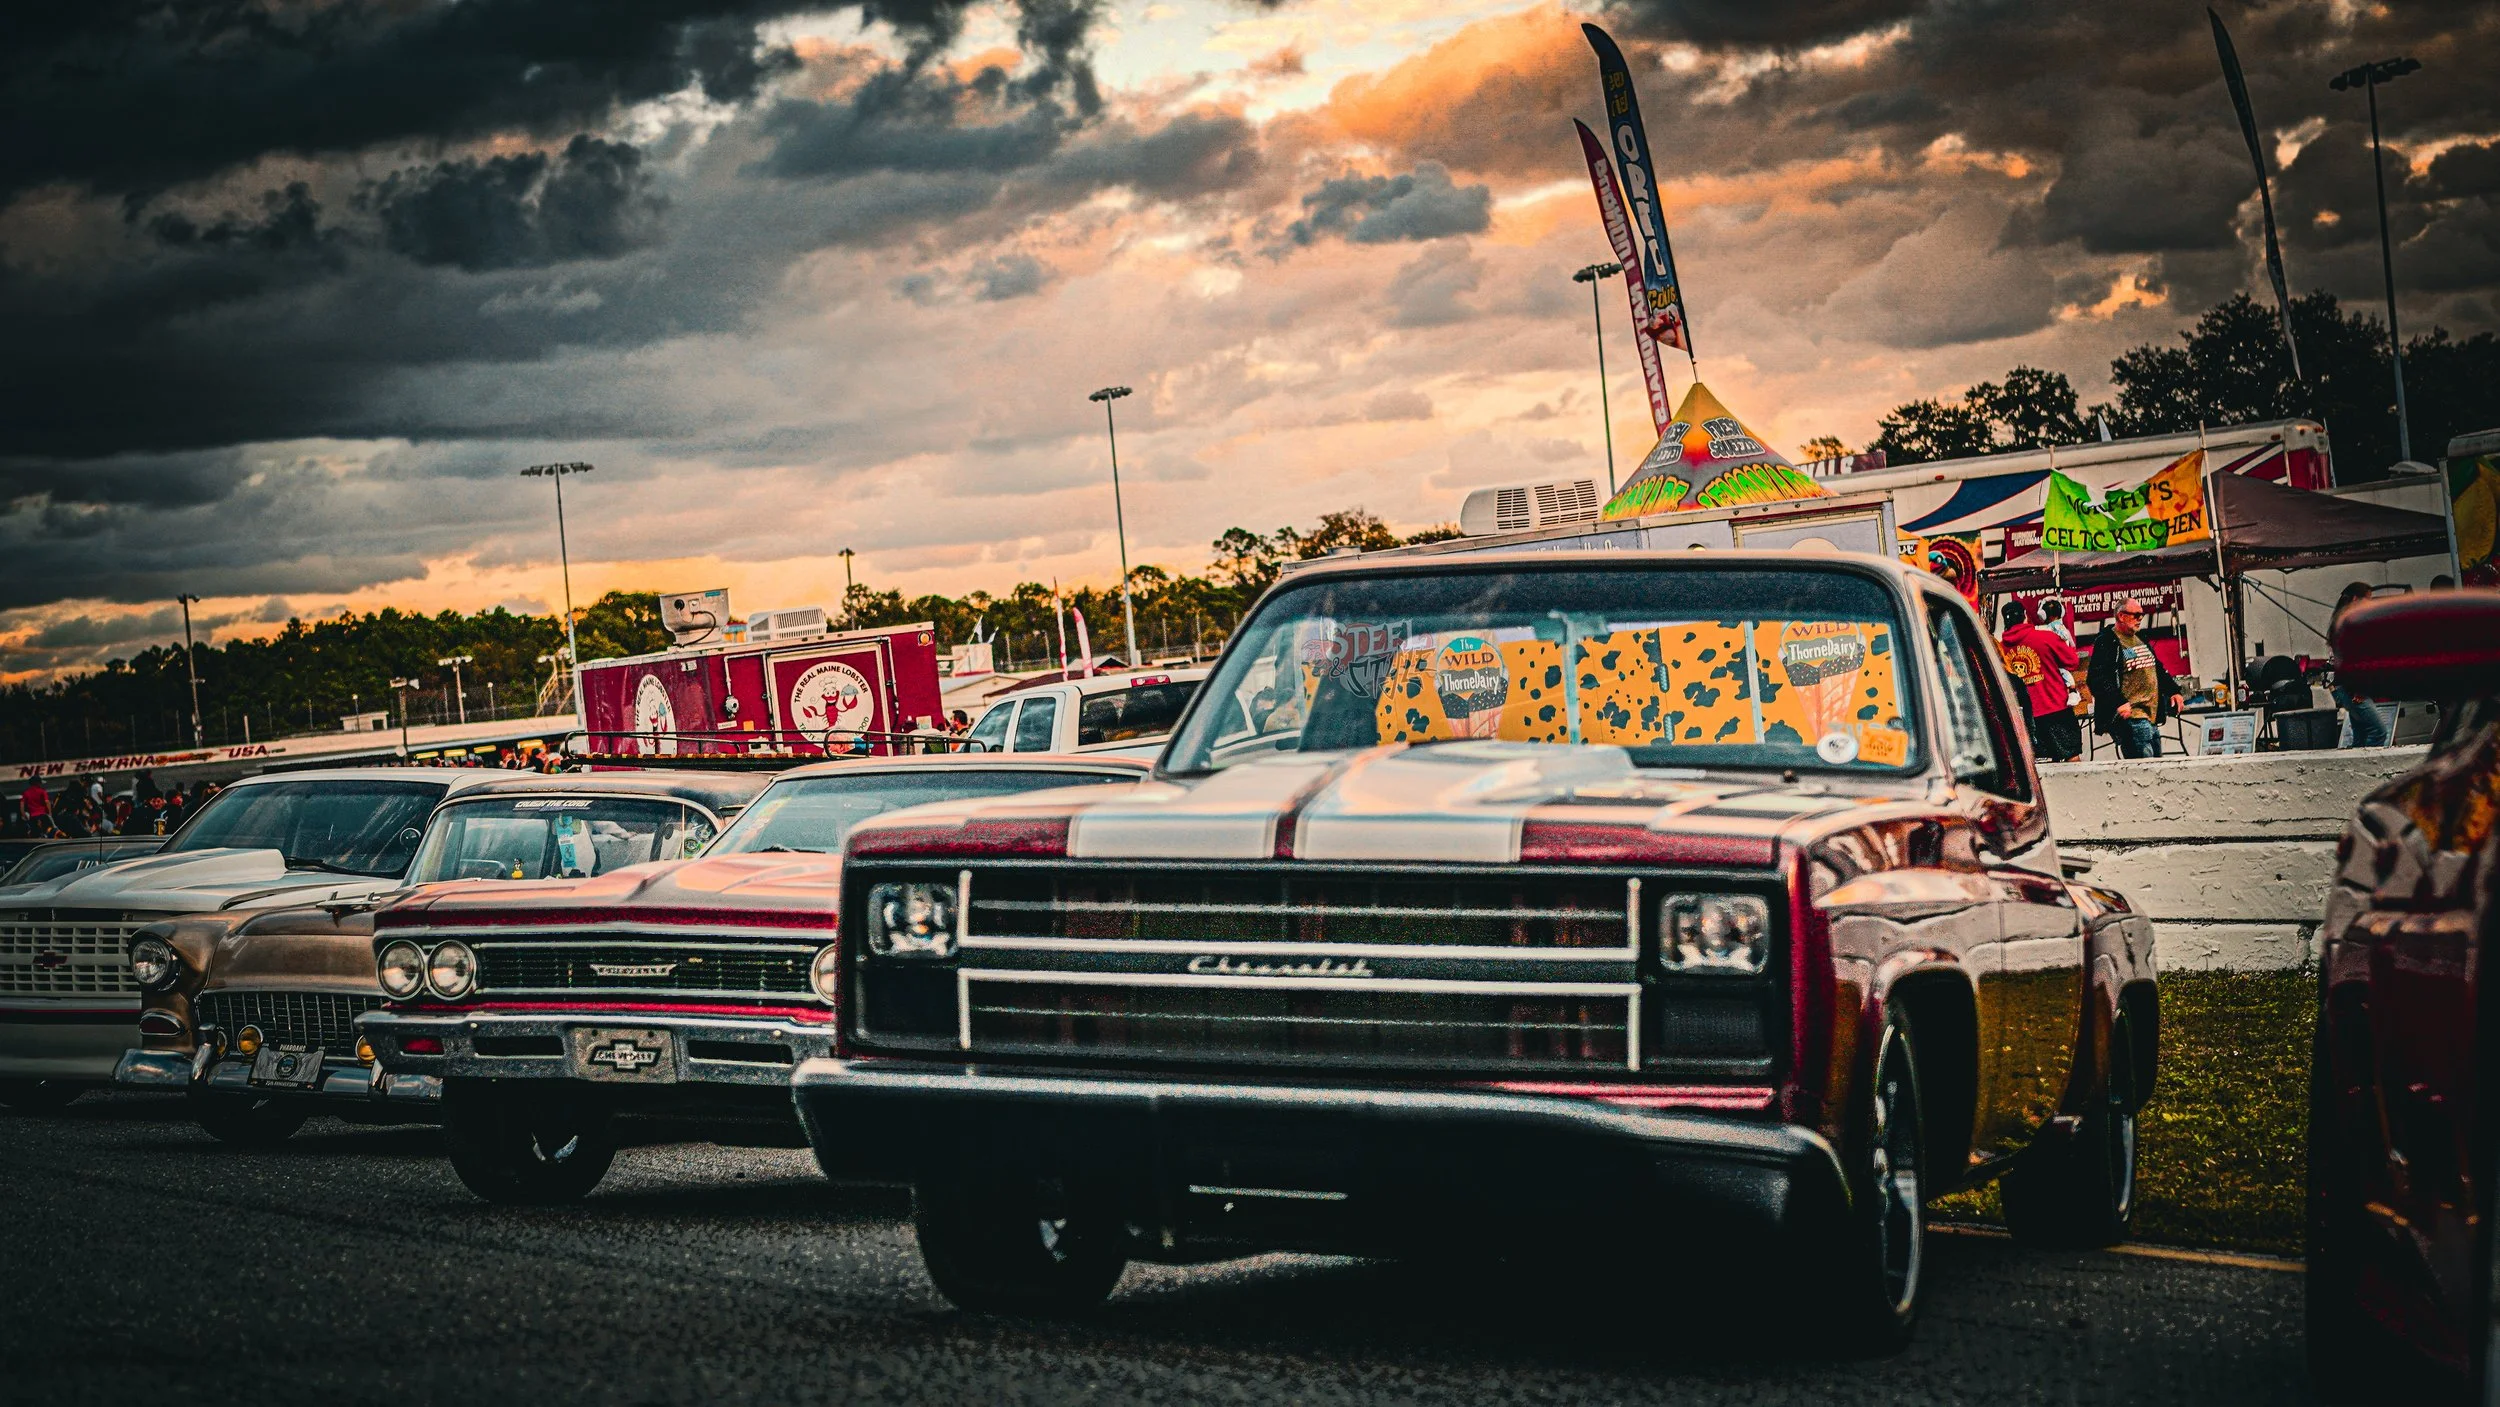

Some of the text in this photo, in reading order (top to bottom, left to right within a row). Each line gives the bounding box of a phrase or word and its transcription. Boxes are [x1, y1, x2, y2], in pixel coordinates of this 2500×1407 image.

[2109, 510, 2202, 545] KITCHEN
[2077, 595, 2087, 603] AT
[2087, 593, 2102, 602] 4PM
[2112, 590, 2129, 600] NEW
[2130, 587, 2159, 598] SMYRNA
[2074, 602, 2101, 613] TICKETS
[1326, 618, 1413, 662] STEEL
[1791, 623, 1850, 637] WILD
[1459, 638, 1474, 650] The
[1788, 638, 1857, 661] ThorneDairy
[1329, 657, 1346, 678] &
[1444, 652, 1495, 667] WILD
[794, 665, 869, 703] THE REAL MAINE LOBSTER
[1442, 670, 1500, 693] ThorneDairy
[18, 762, 65, 778] NEW
[74, 755, 157, 773] SMYRNA
[227, 744, 268, 759] USA
